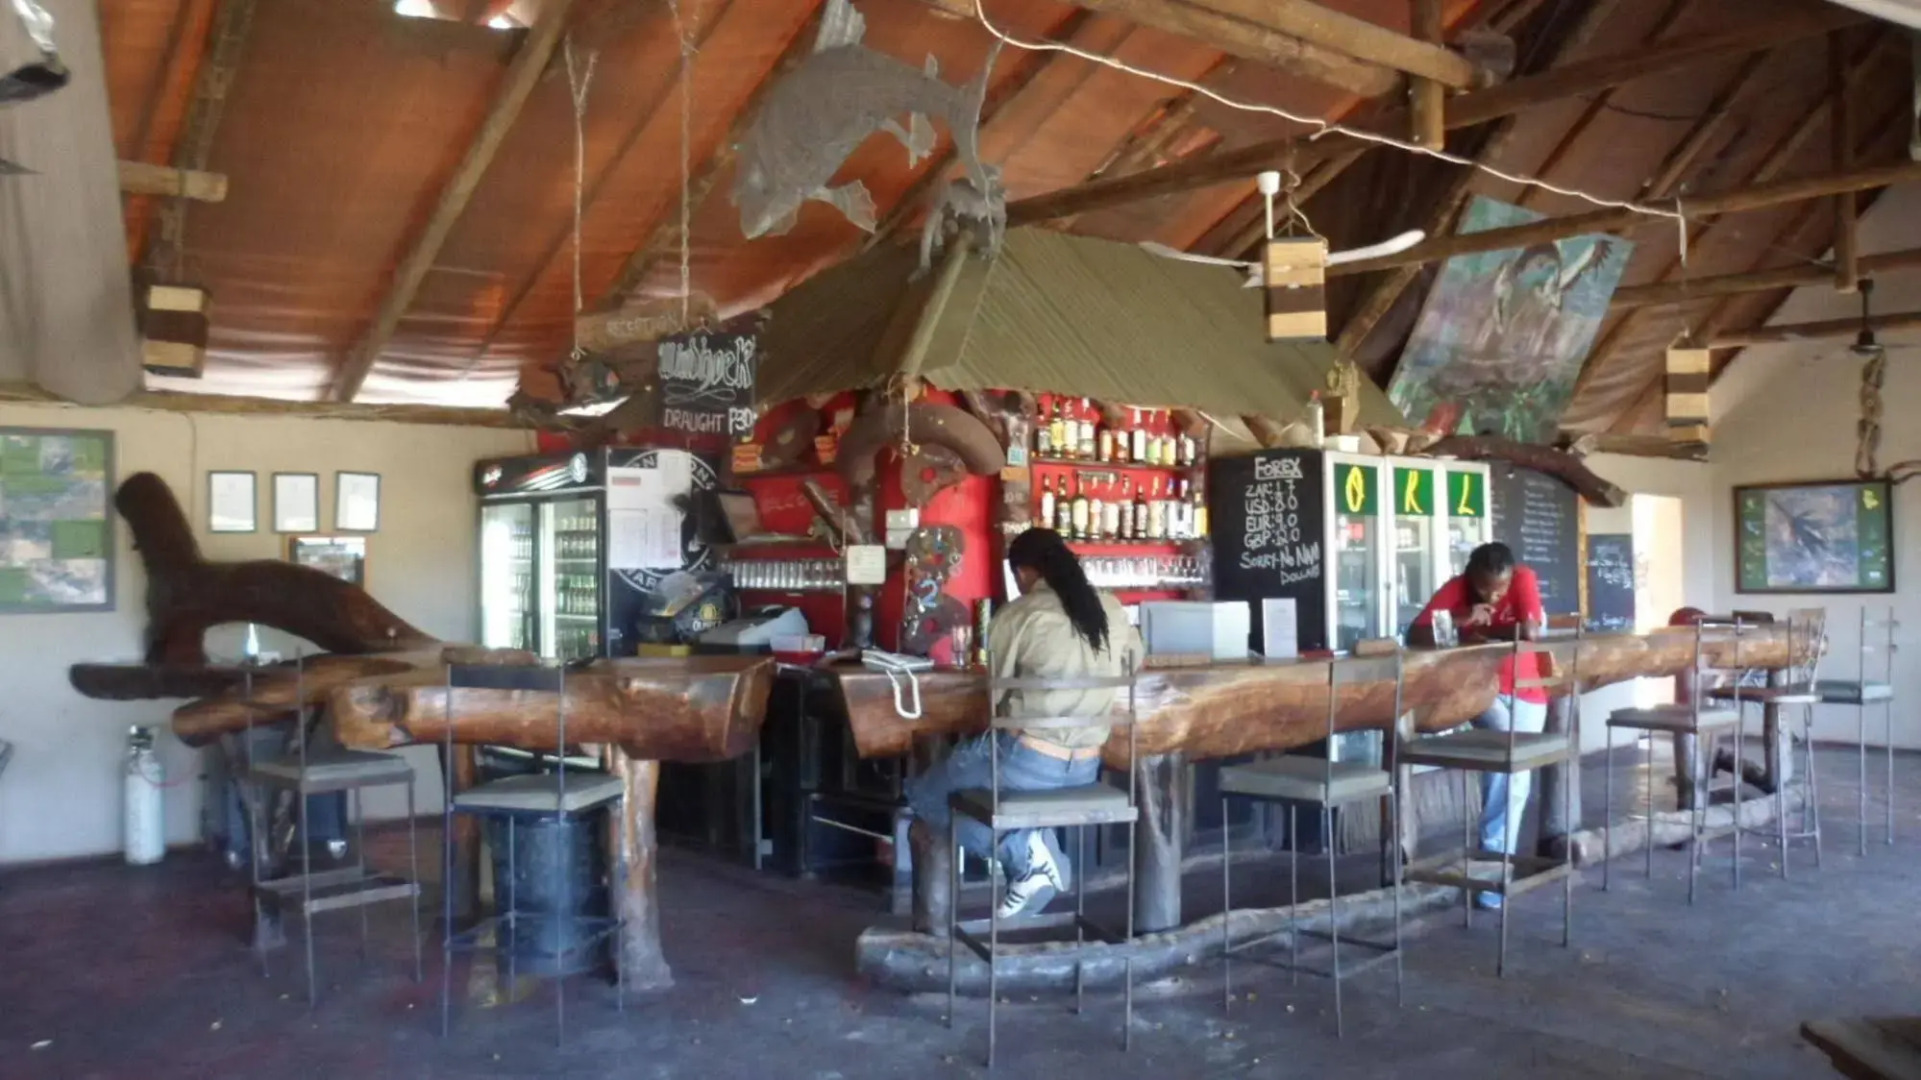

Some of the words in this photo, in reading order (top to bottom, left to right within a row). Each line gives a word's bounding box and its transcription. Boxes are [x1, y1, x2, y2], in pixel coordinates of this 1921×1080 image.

[663, 407, 725, 433] DRAUGHT
[1404, 470, 1423, 514] R
[1457, 474, 1475, 515] L
